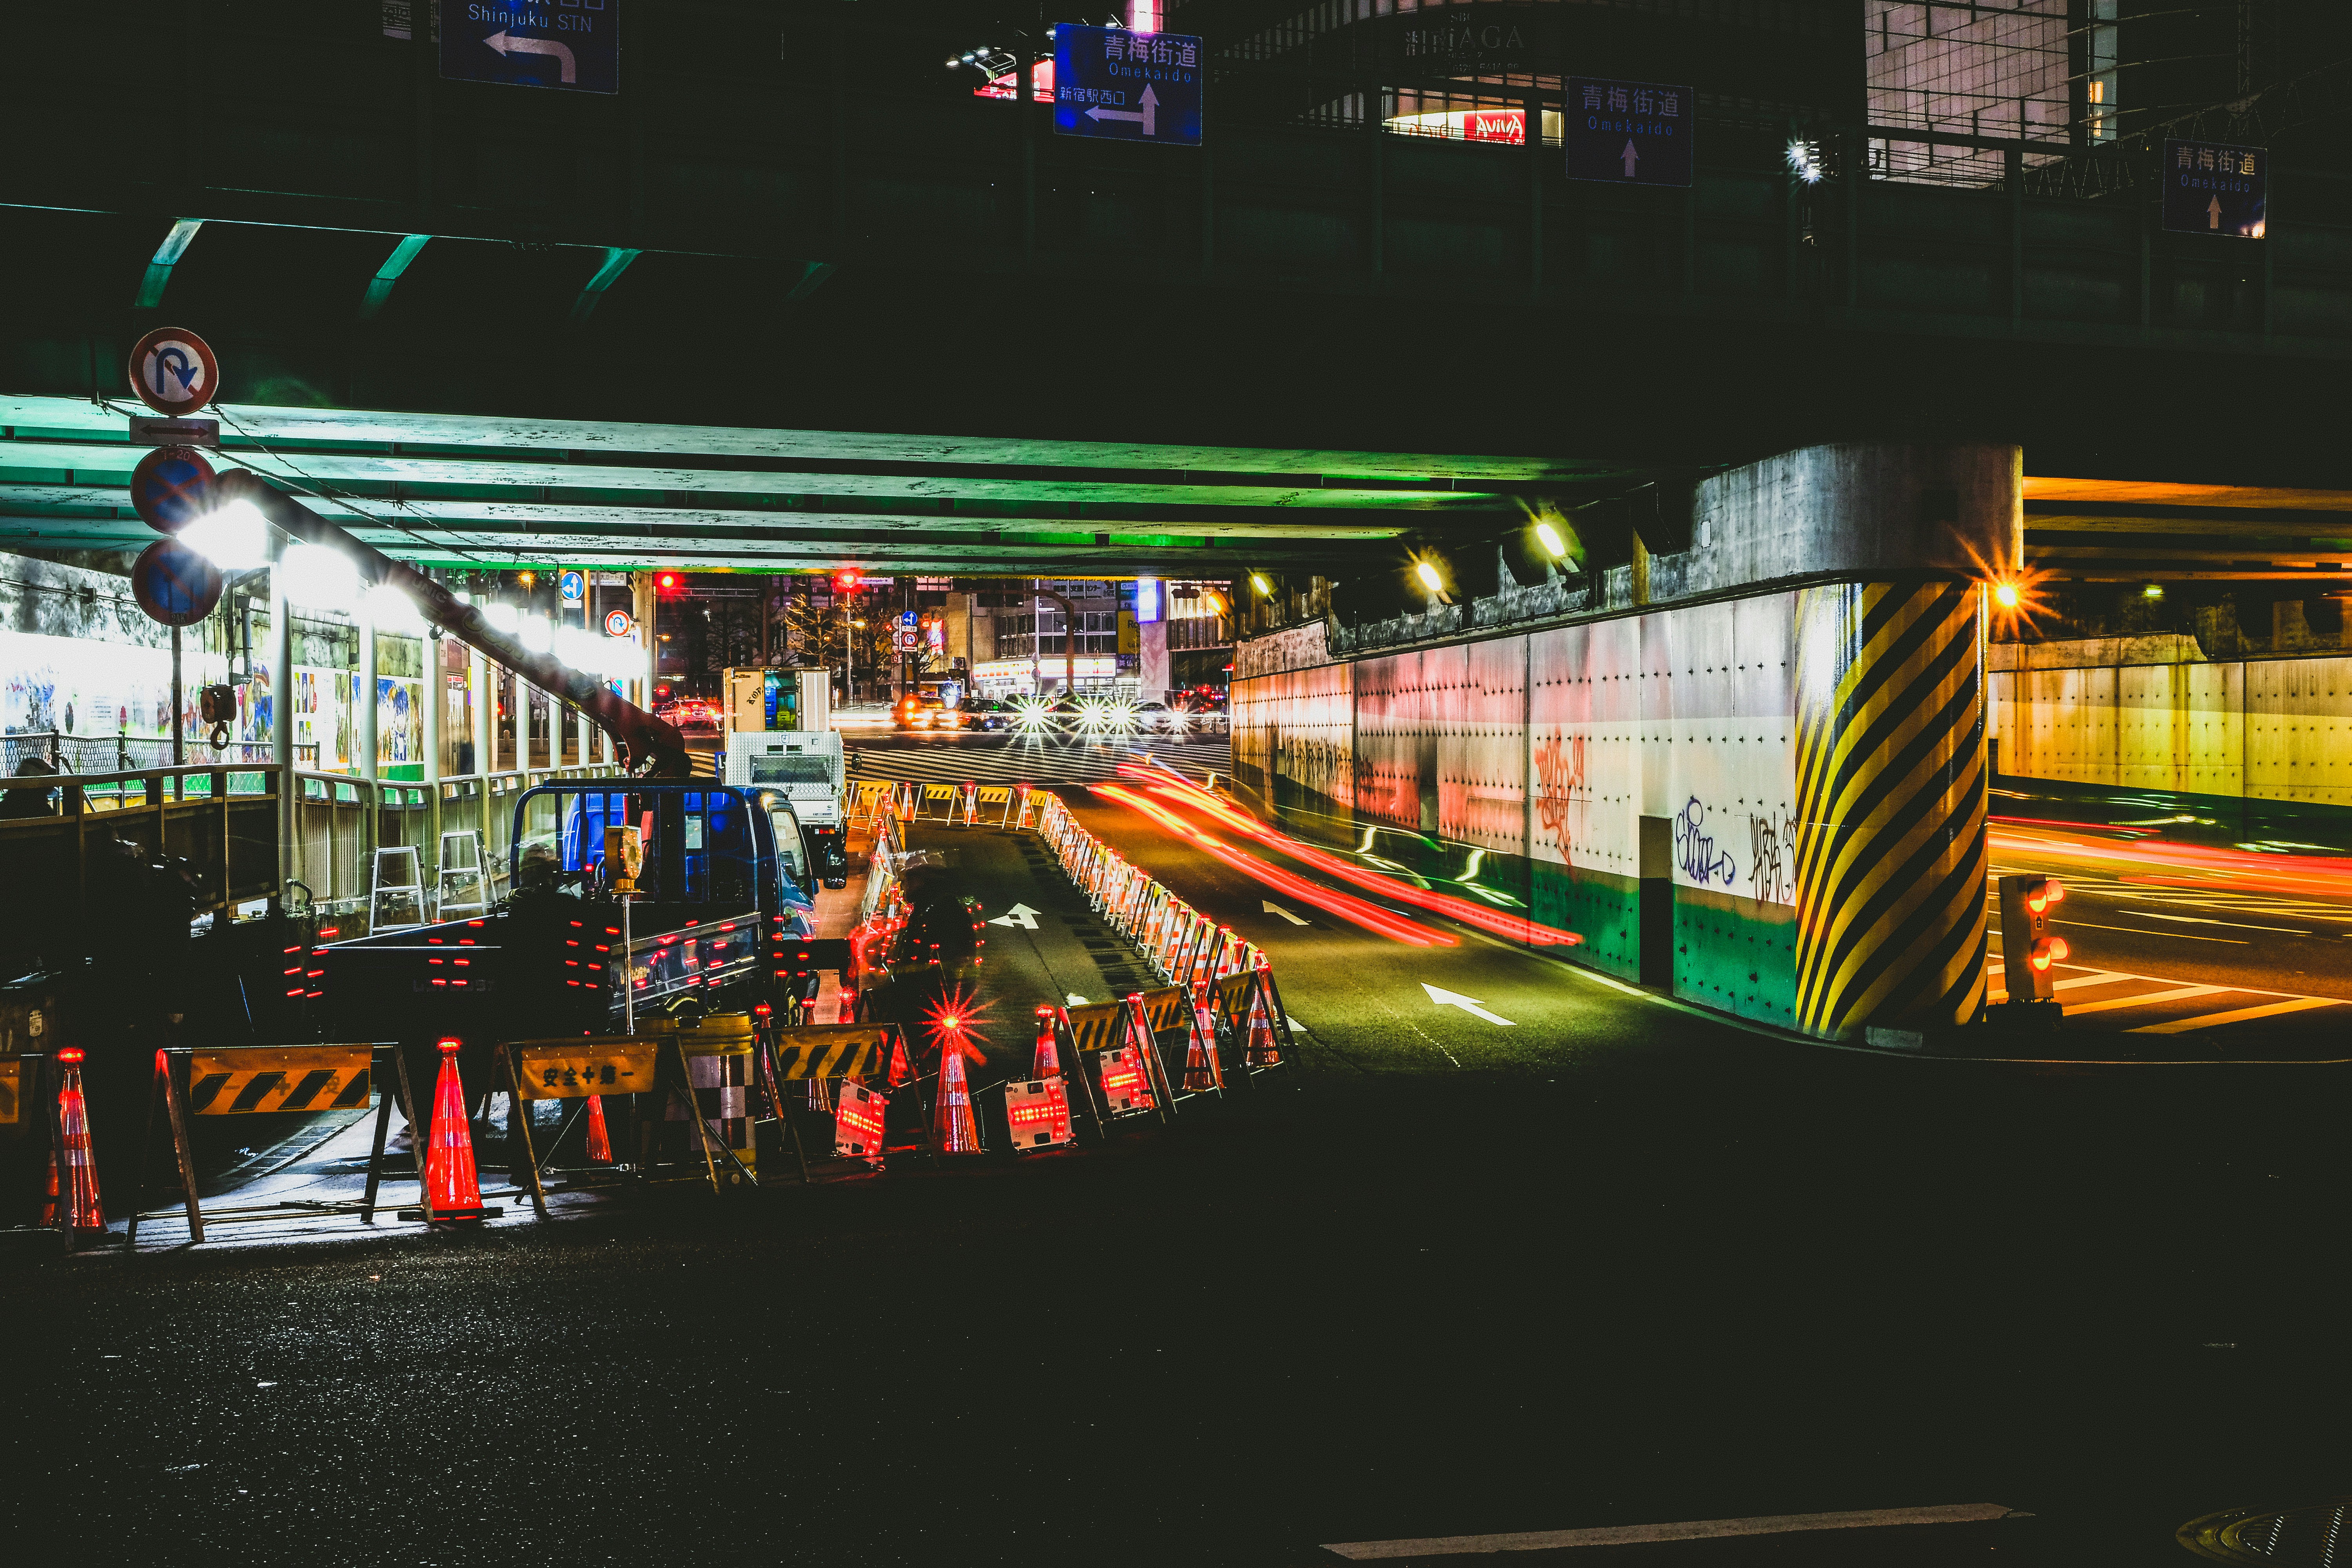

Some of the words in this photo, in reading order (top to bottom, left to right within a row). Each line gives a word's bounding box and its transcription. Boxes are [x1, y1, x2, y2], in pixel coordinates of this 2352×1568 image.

[468, 4, 548, 28] Shinjuku
[1104, 35, 1196, 67] 青梅街道
[1109, 62, 1191, 83] Omekaido
[1060, 87, 1125, 105] 新宿駅西口
[1582, 84, 1679, 117] 青梅街道
[1588, 115, 1672, 136] Omekaido
[2177, 146, 2255, 175] 青梅街道
[2181, 174, 2249, 192] Omekaido
